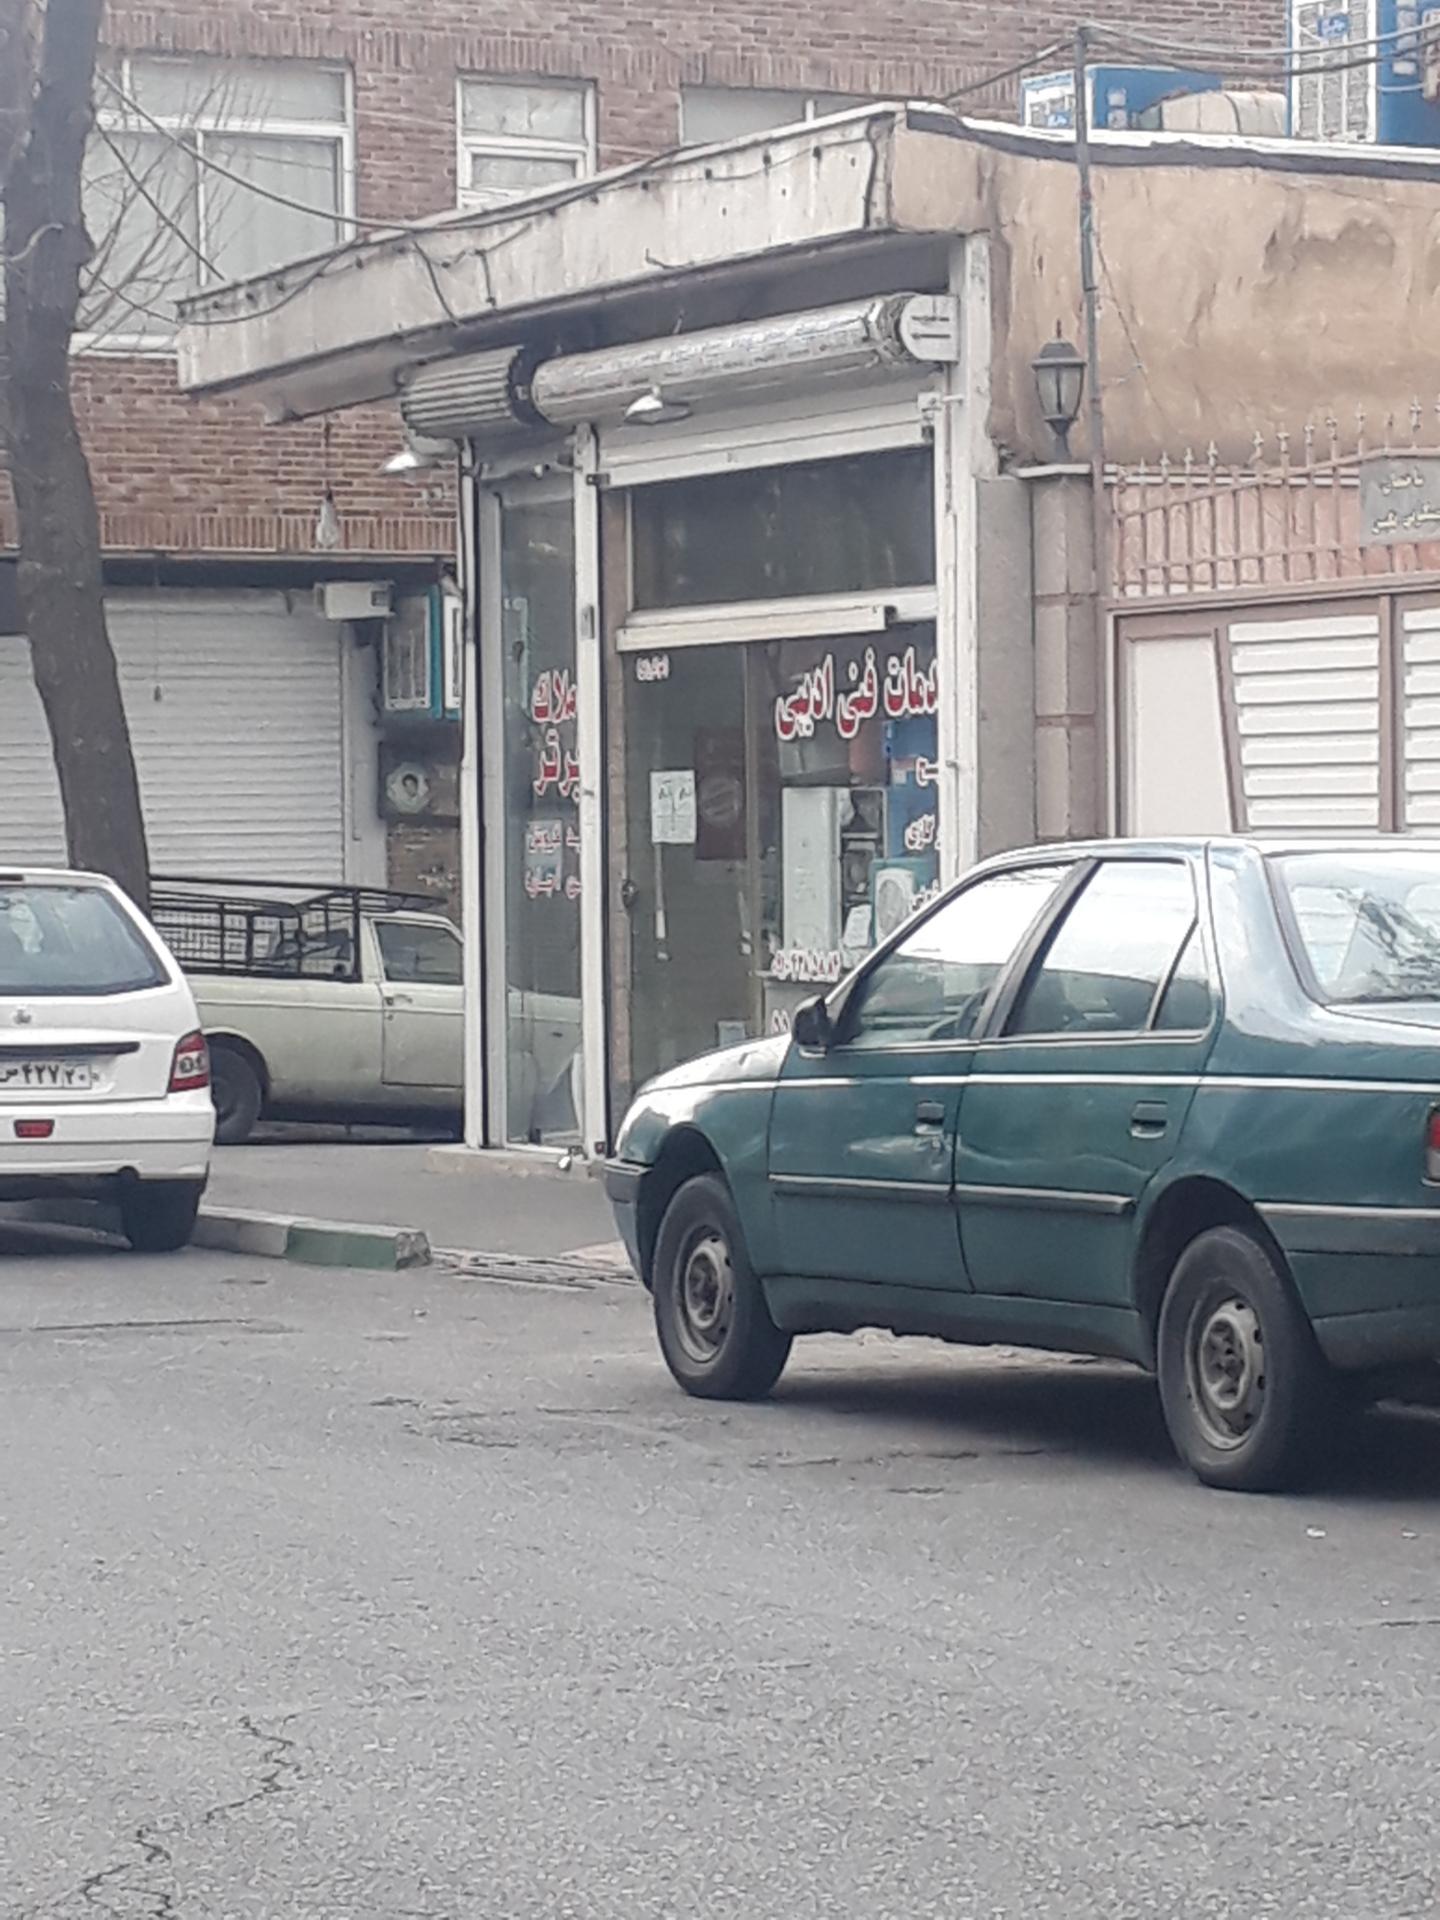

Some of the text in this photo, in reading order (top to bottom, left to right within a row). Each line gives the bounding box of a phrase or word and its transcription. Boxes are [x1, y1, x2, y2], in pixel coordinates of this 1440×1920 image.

[531, 669, 577, 724] ملاک
[836, 646, 878, 739] فنی
[882, 646, 938, 717] دمات
